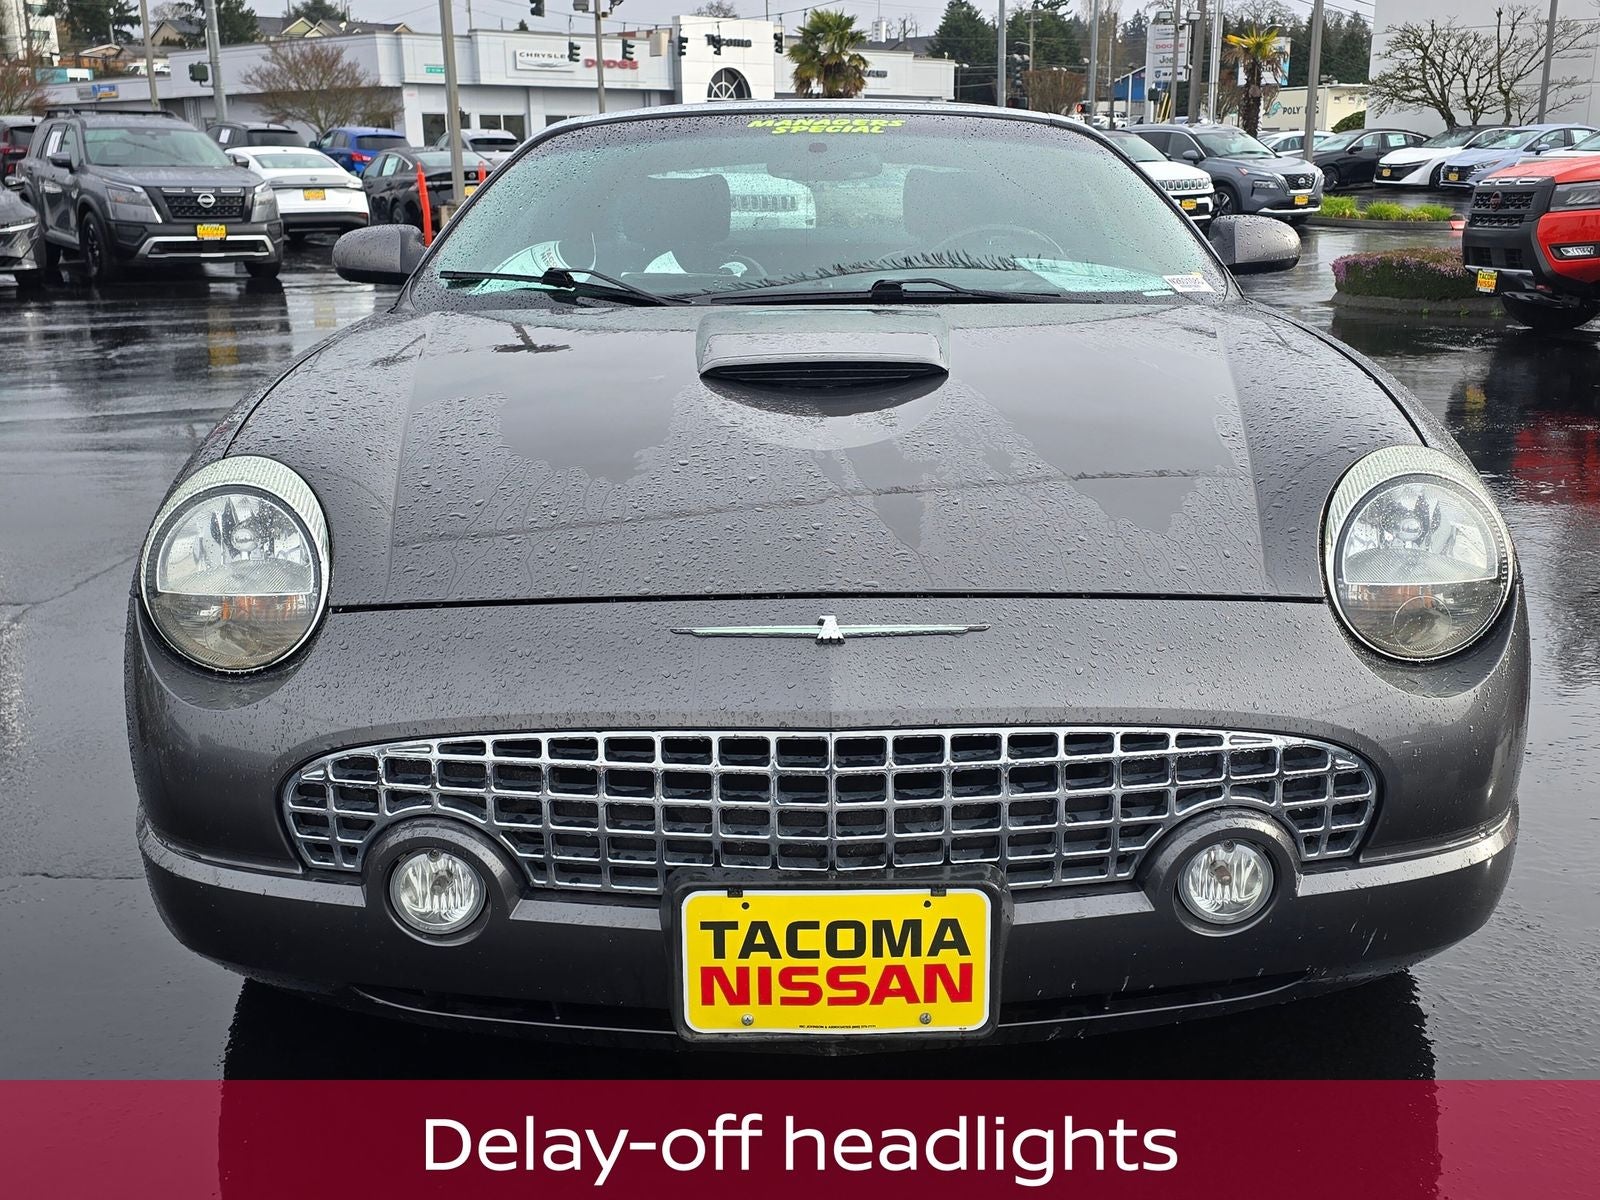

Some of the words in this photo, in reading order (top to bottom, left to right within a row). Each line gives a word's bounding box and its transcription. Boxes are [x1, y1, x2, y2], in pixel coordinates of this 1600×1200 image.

[519, 51, 567, 59] CHRYSLE
[584, 58, 639, 70] DDGE
[747, 118, 905, 128] MANAGERS
[772, 125, 885, 134] SPECIAL
[700, 918, 971, 959] TACOMA
[700, 963, 973, 1006] NISSAN
